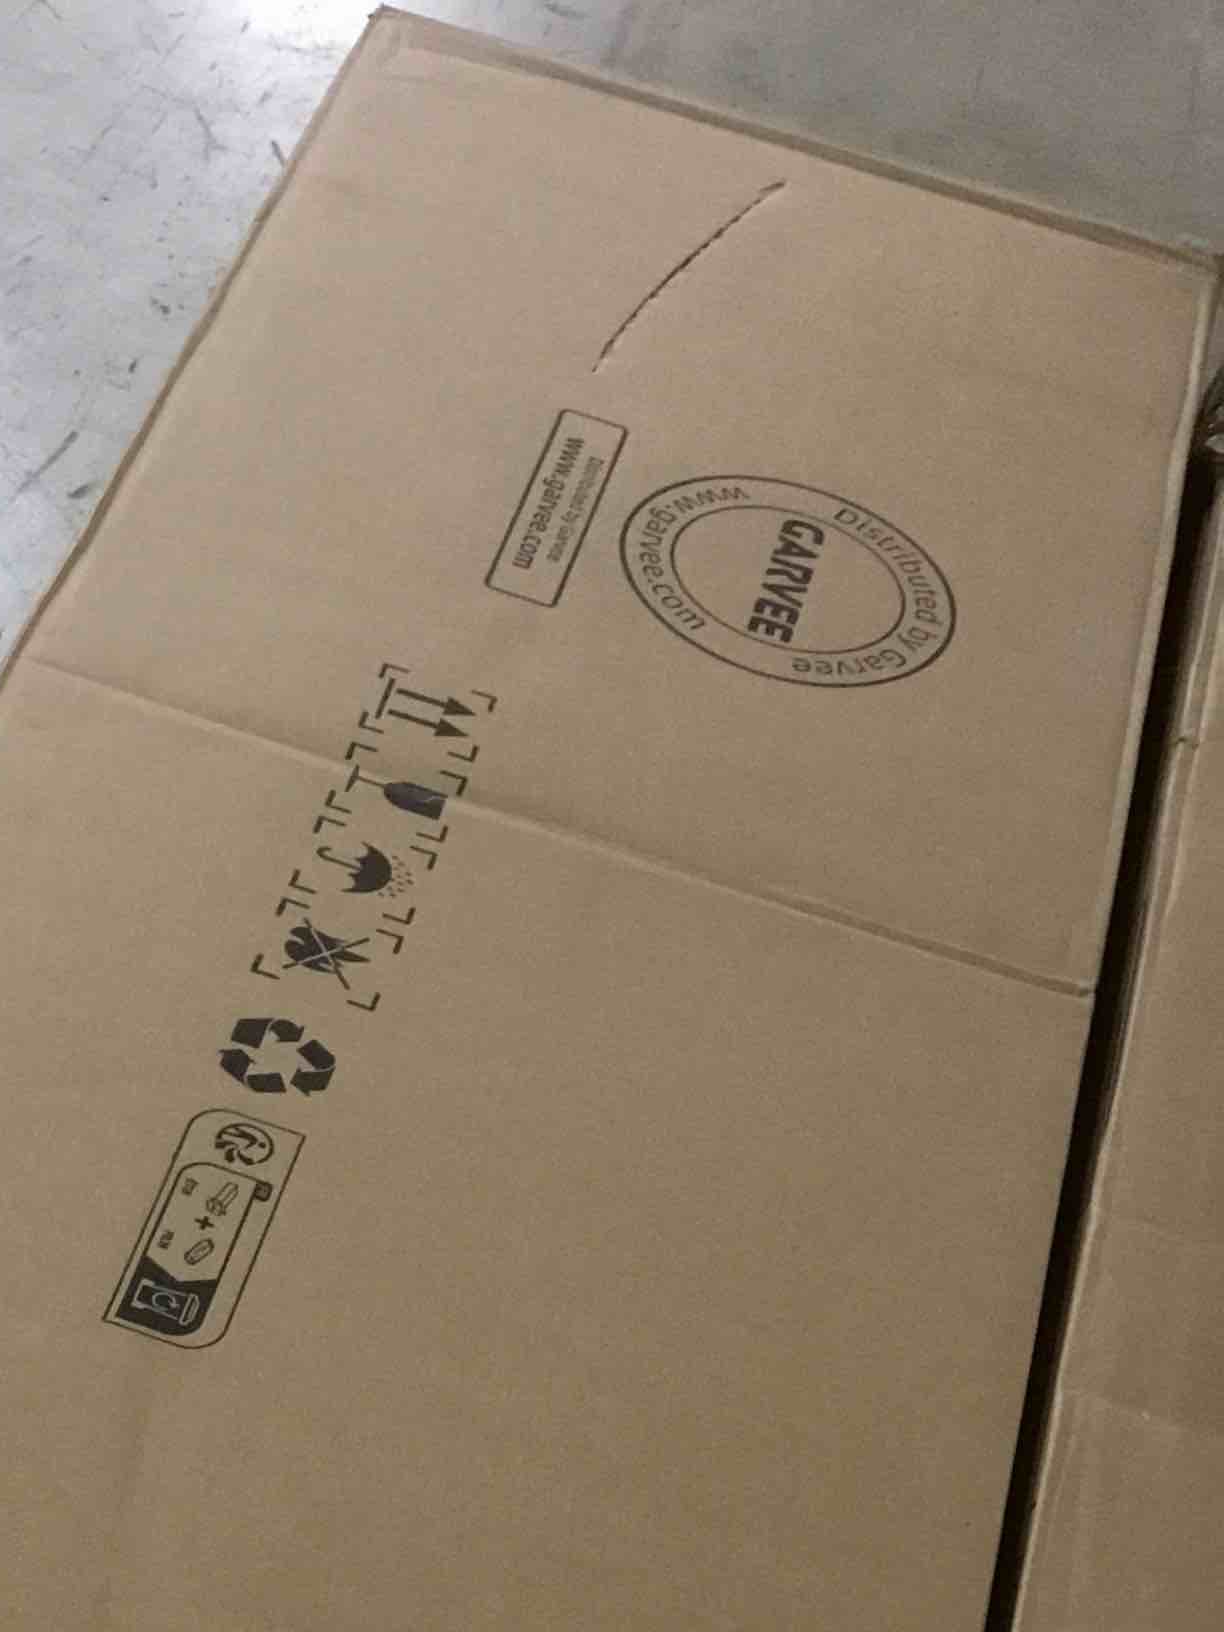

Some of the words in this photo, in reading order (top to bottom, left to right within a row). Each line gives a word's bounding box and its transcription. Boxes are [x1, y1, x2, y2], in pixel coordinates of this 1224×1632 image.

[512, 437, 584, 570] www.garvee.com
[638, 485, 751, 632] www.garvee.com
[748, 519, 825, 644] GARVEE
[833, 508, 938, 624] Distributed
[792, 654, 907, 679] Garvee
[901, 624, 937, 659] by
